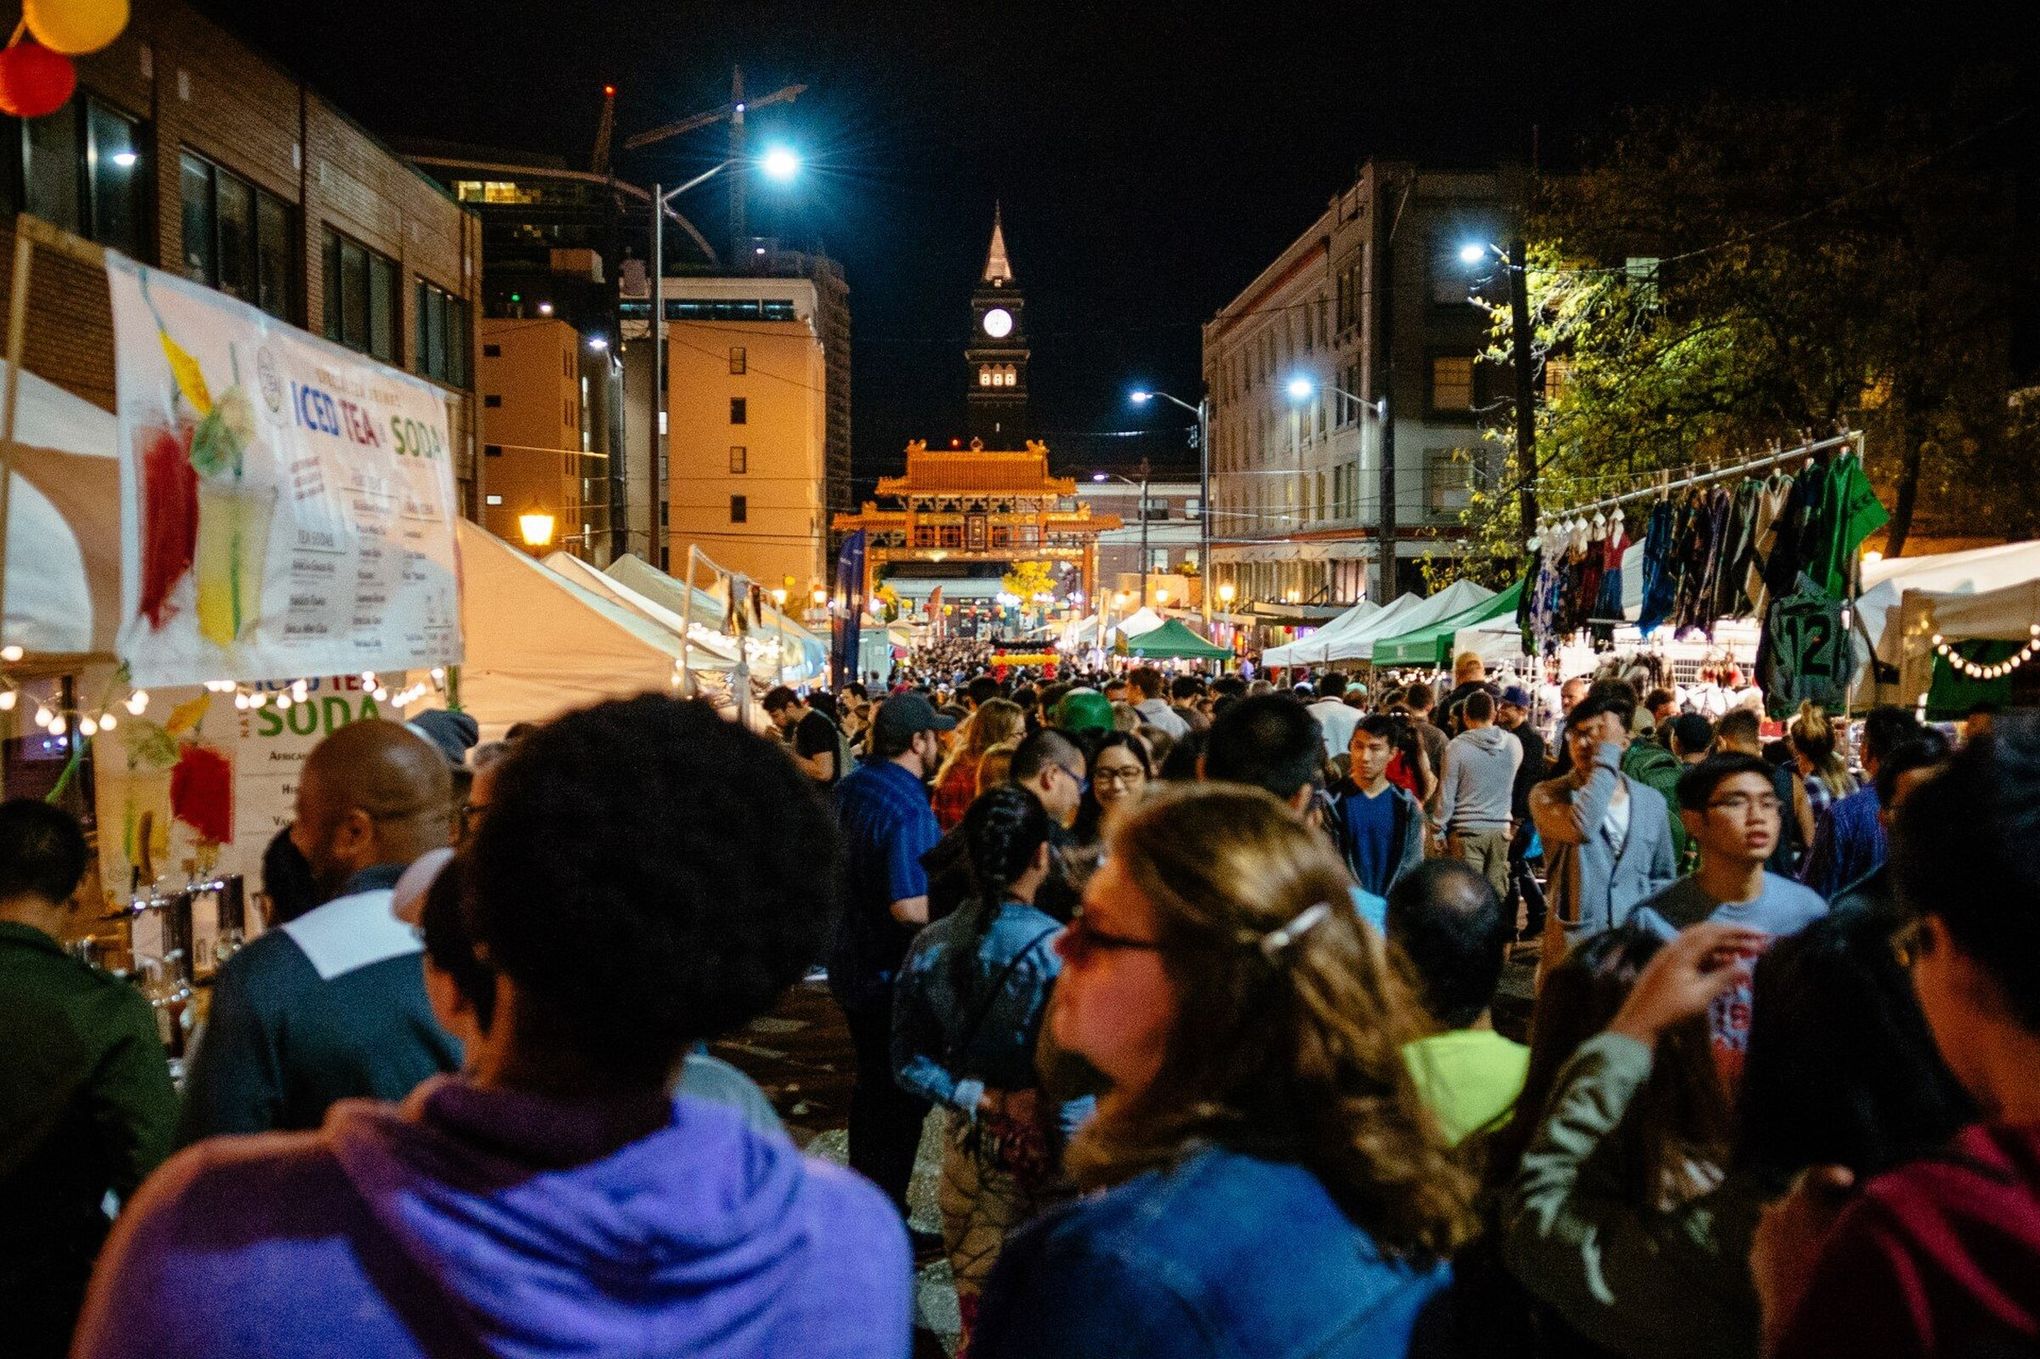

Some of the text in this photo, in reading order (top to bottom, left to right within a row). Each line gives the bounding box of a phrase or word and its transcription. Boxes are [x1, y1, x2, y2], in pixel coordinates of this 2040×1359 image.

[290, 380, 339, 437] ICED
[340, 399, 379, 448] TEA
[390, 415, 442, 459] SODA
[1785, 613, 1832, 677] 12
